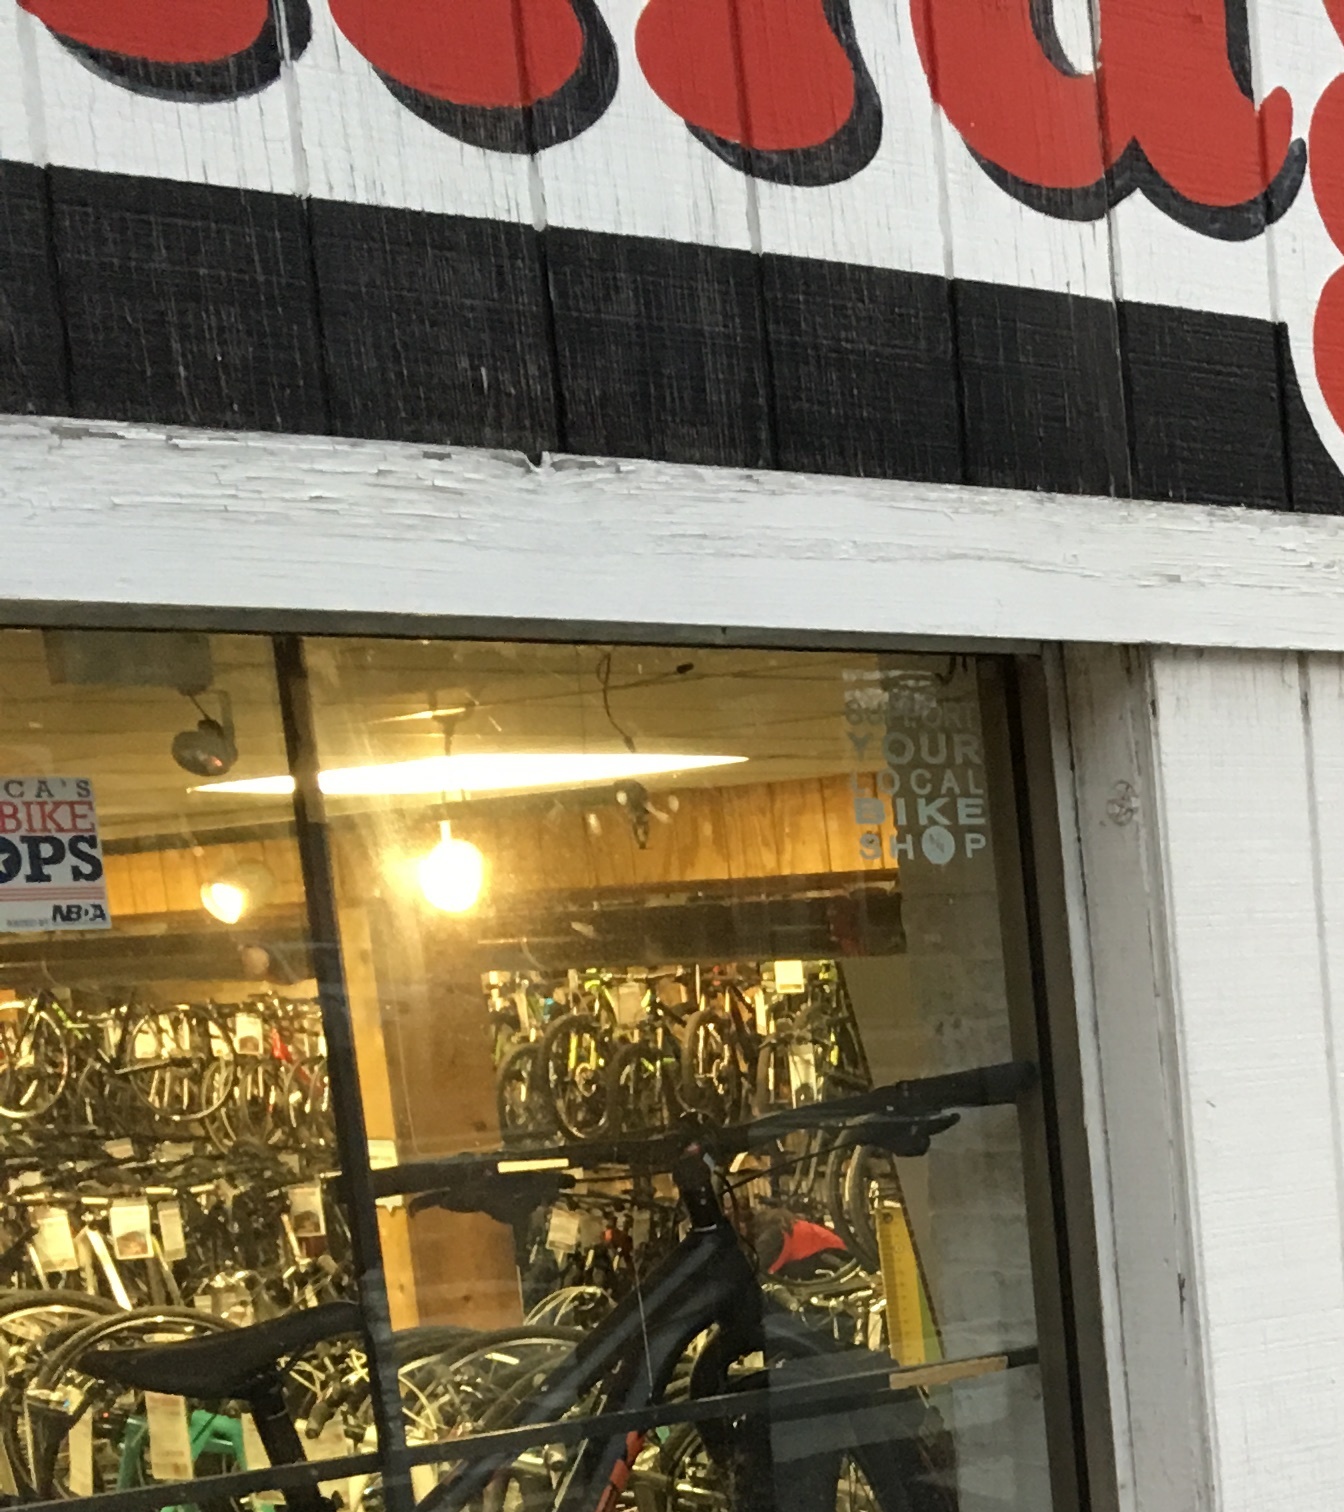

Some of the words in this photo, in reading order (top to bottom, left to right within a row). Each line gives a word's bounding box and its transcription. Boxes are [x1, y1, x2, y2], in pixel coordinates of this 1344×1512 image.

[846, 731, 985, 765] YOUR
[852, 768, 985, 796] LOCAL
[0, 800, 96, 834] BIKE
[853, 797, 987, 827] BIKE
